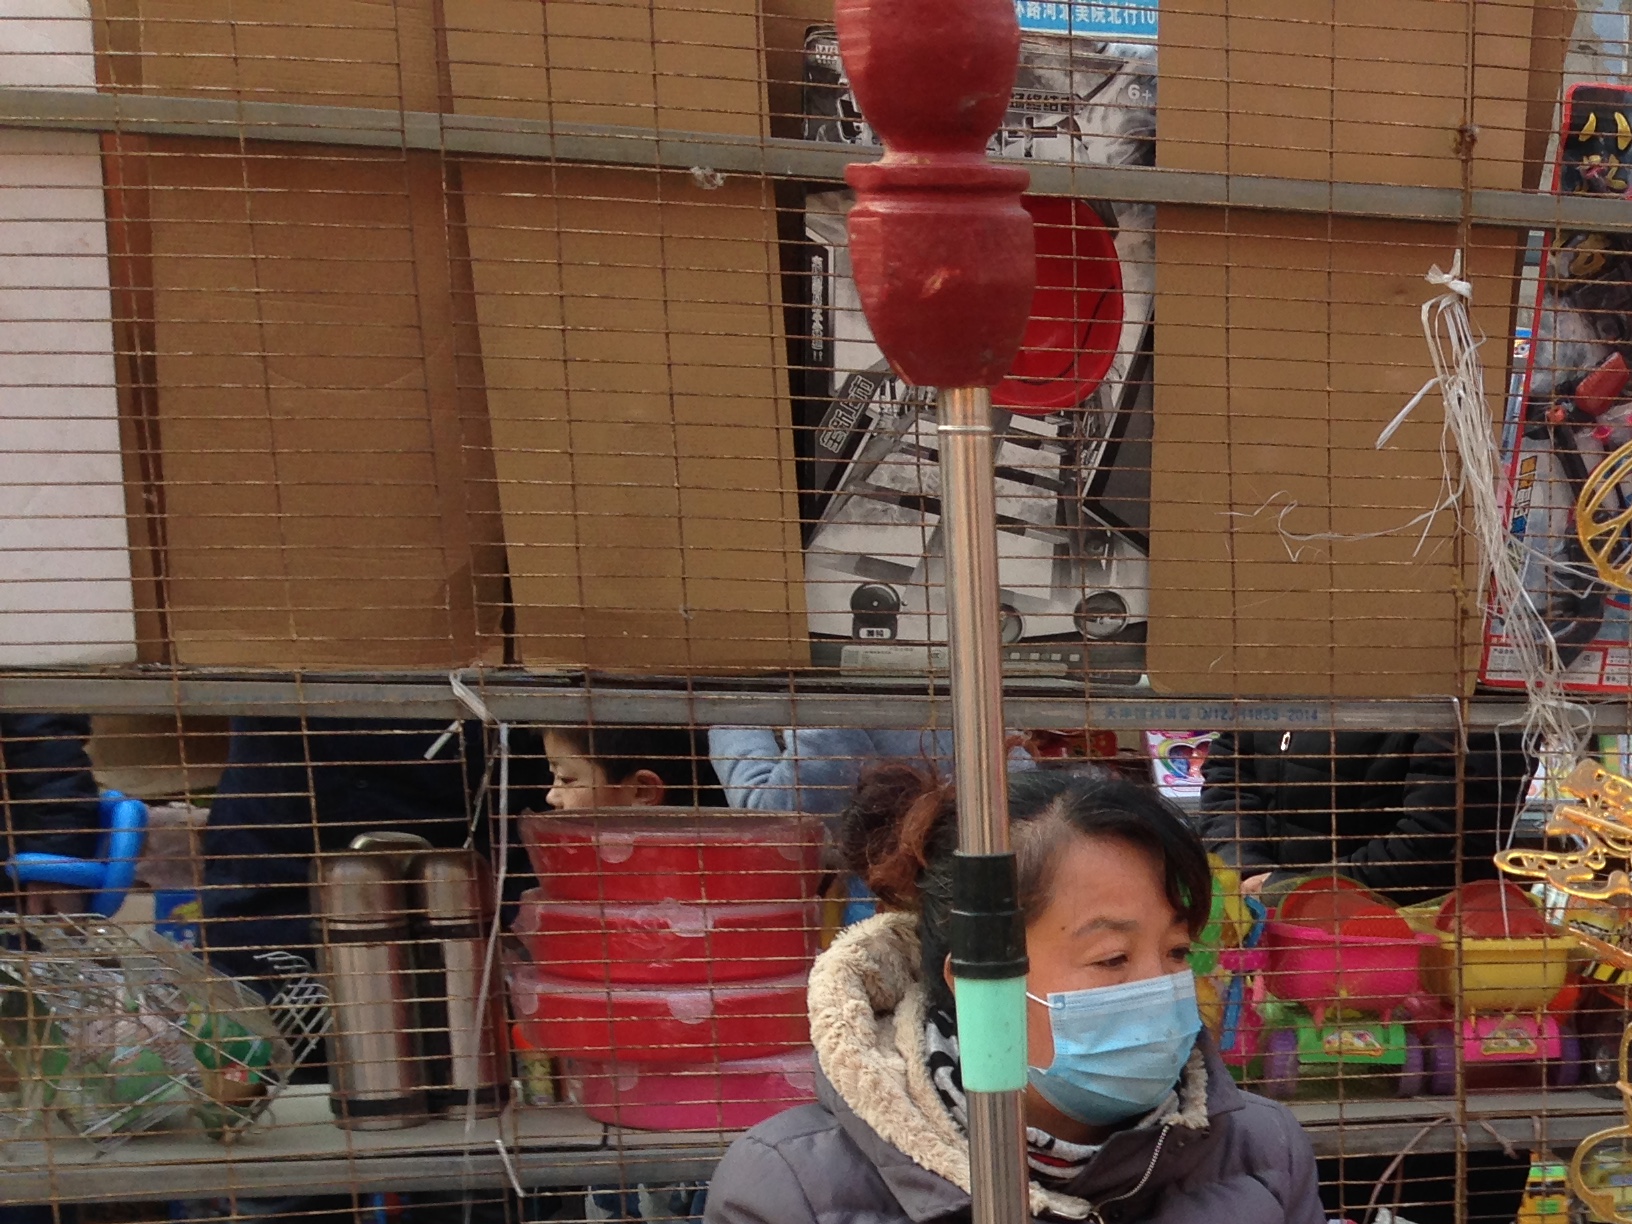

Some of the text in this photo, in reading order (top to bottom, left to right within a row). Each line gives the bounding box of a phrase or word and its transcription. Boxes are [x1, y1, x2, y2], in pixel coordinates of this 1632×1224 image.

[1127, 84, 1152, 101] 6+
[820, 375, 874, 453] 全新上市
